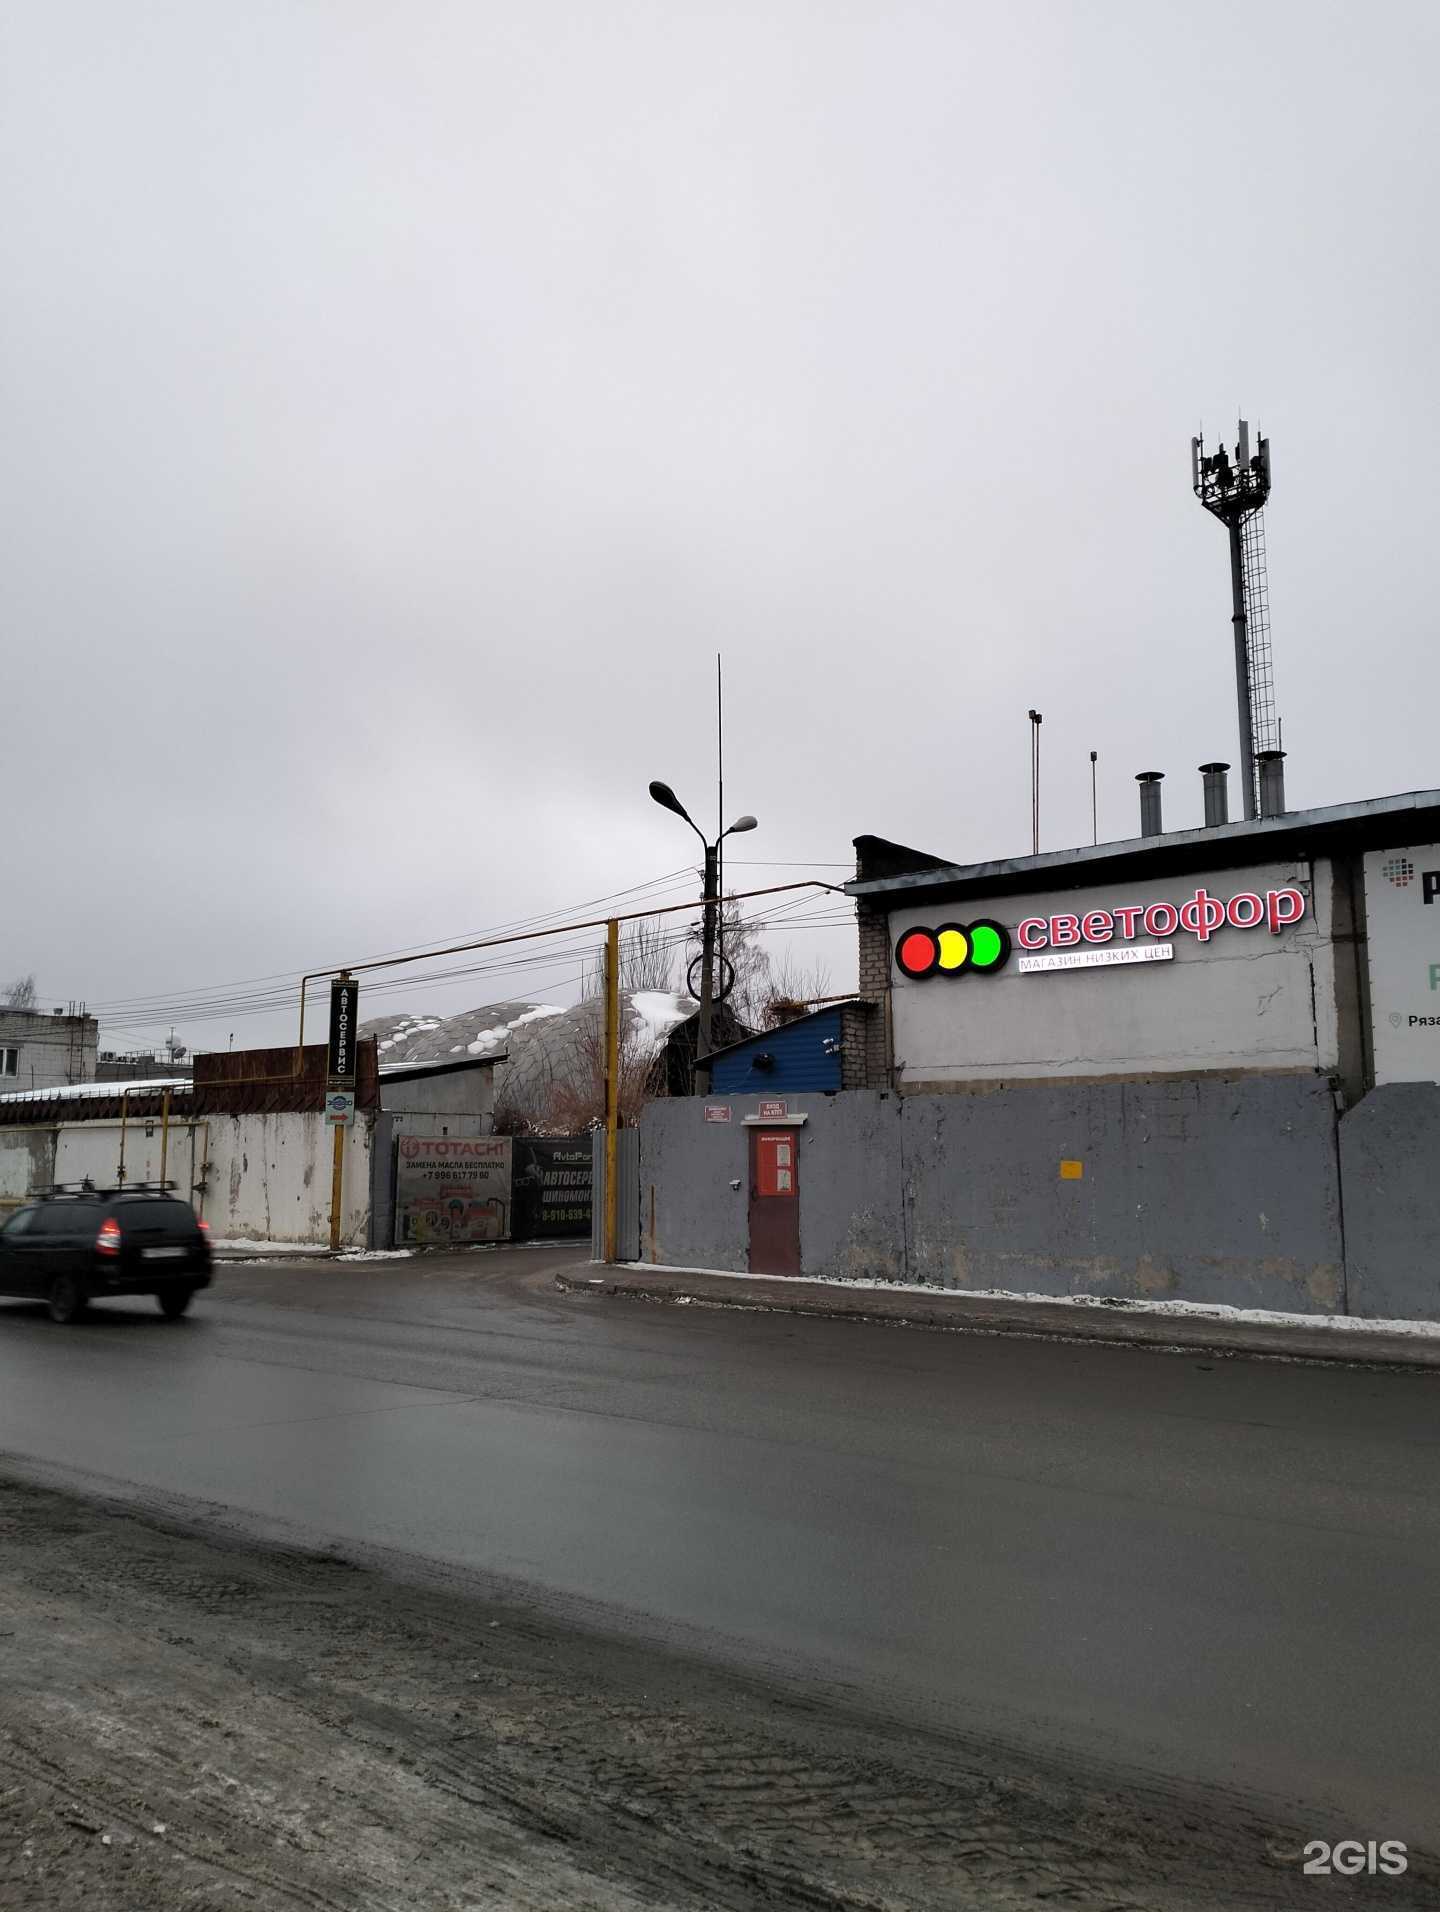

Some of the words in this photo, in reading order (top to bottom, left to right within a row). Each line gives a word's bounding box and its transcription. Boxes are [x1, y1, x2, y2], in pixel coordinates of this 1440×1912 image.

[1018, 887, 1305, 950] светофор
[1020, 954, 1081, 971] МАГАЗИН
[1086, 949, 1139, 964] НИЗКИХ
[1144, 946, 1170, 960] ЦЕН
[337, 988, 349, 1074] АВТОСЕРВИС
[421, 1141, 504, 1156] TOTACHI
[406, 1161, 436, 1169] ЗАМЕНА
[438, 1161, 463, 1169] МАСЛА
[464, 1161, 505, 1169] БЕСПЛАТНО
